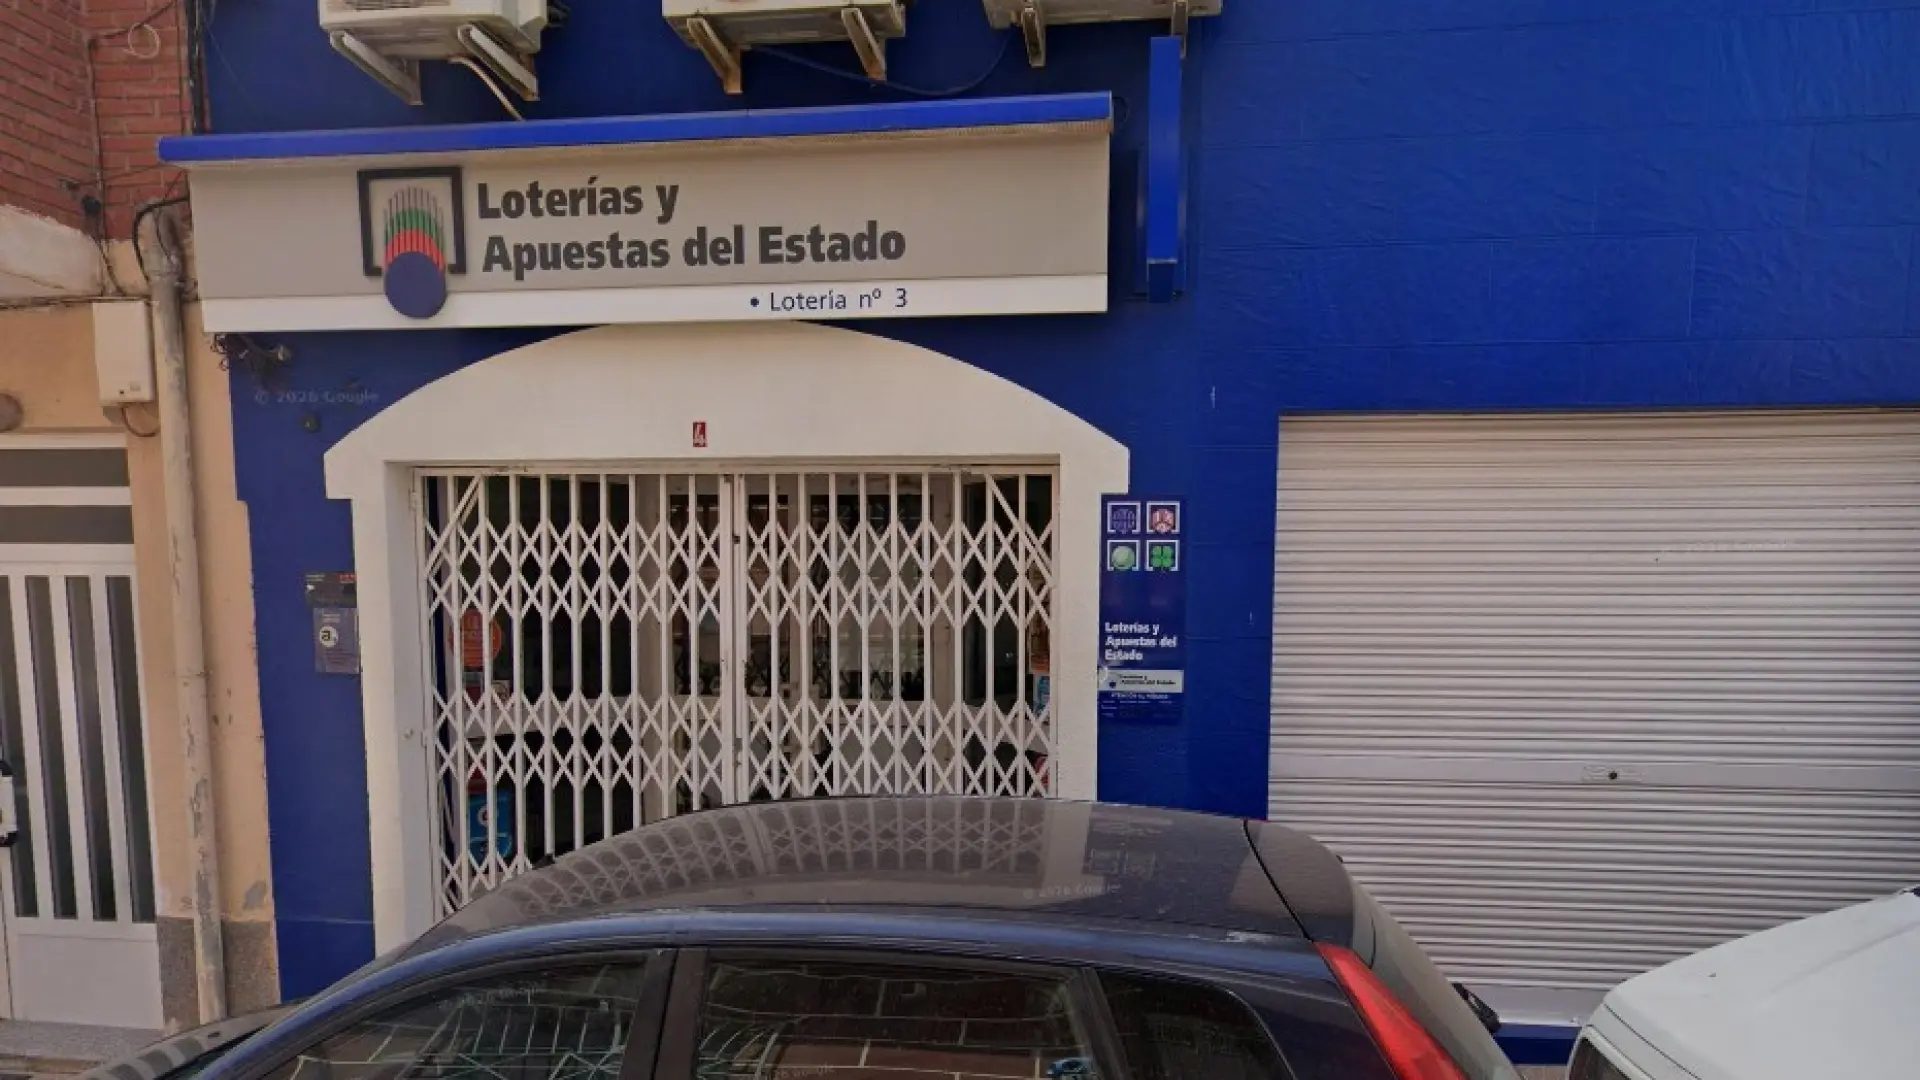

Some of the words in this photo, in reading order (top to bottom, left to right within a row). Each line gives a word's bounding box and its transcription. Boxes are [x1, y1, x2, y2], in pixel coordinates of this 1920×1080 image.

[478, 175, 644, 219] Loterías
[656, 184, 679, 224] y
[482, 231, 671, 280] Apuestas
[683, 224, 745, 266] del
[758, 220, 906, 264] Estado
[895, 288, 908, 308] 3
